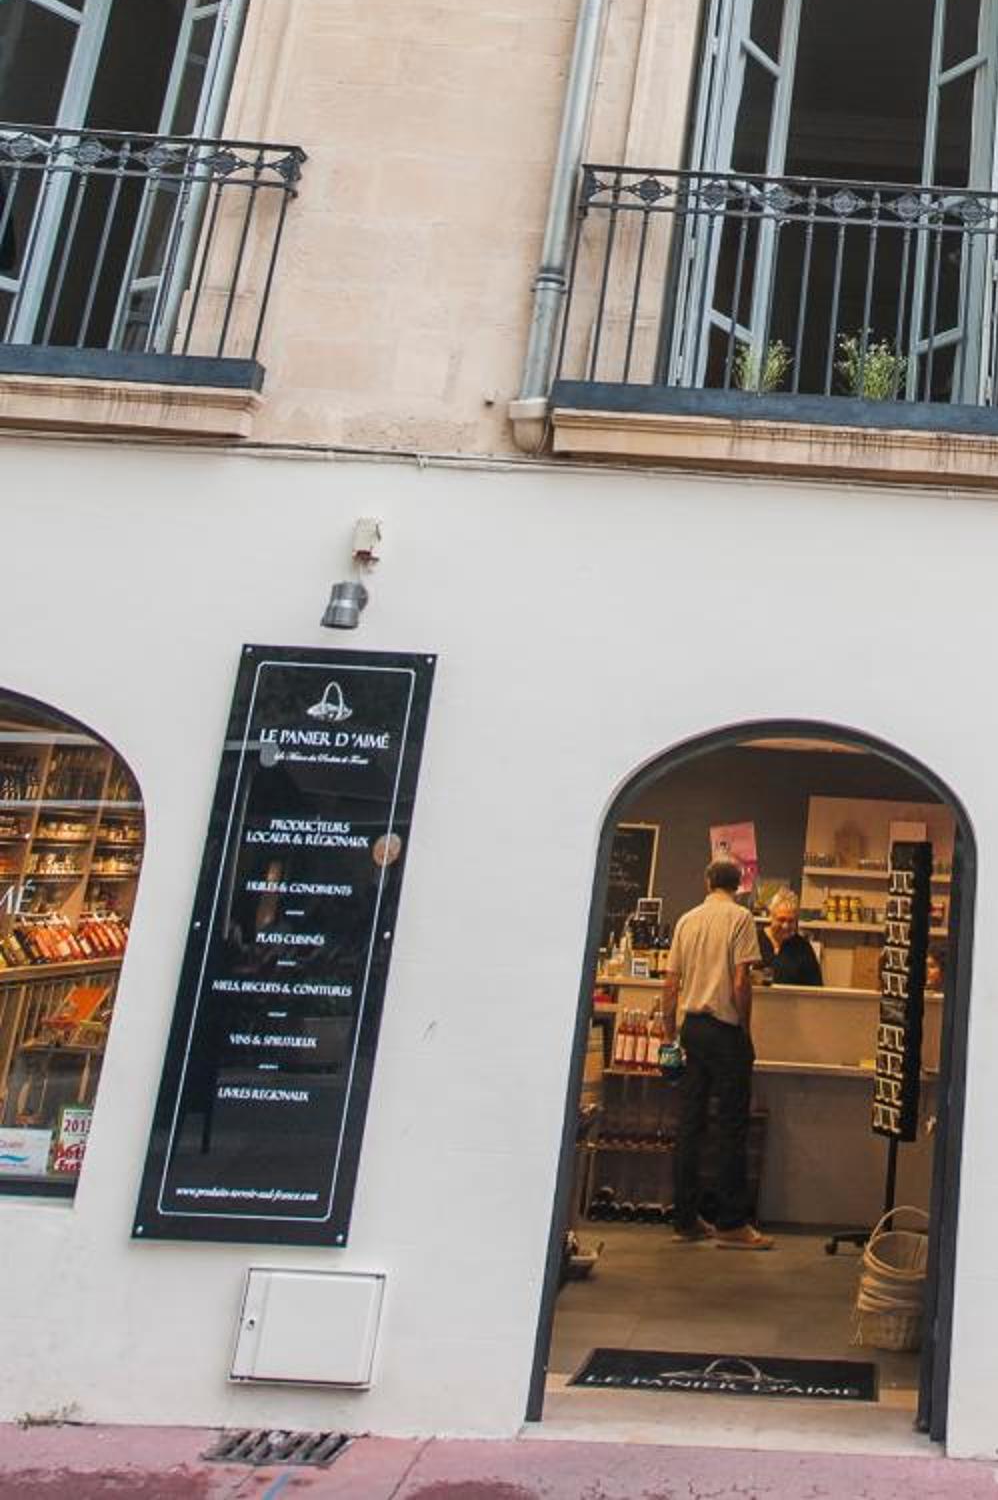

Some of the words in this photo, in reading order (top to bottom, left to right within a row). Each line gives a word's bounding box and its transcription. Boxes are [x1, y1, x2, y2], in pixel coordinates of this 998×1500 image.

[259, 728, 278, 743] LE
[280, 729, 332, 747] PANIER
[269, 818, 351, 833] PRODUCTEURS
[246, 830, 291, 843] LOCAUX
[292, 833, 303, 845] &
[246, 881, 280, 892] HUILES
[289, 882, 353, 896] CONDIMENTS
[255, 931, 283, 944] PLATS
[241, 981, 281, 993] BISCUITS
[281, 983, 291, 994] &
[292, 984, 353, 997] CONFITURES
[229, 1033, 251, 1045] VINS
[251, 1035, 261, 1045] &
[262, 1036, 318, 1048] SPIRITUEUX
[217, 1087, 251, 1099] LIVRES
[632, 1376, 738, 1390] PANIER
